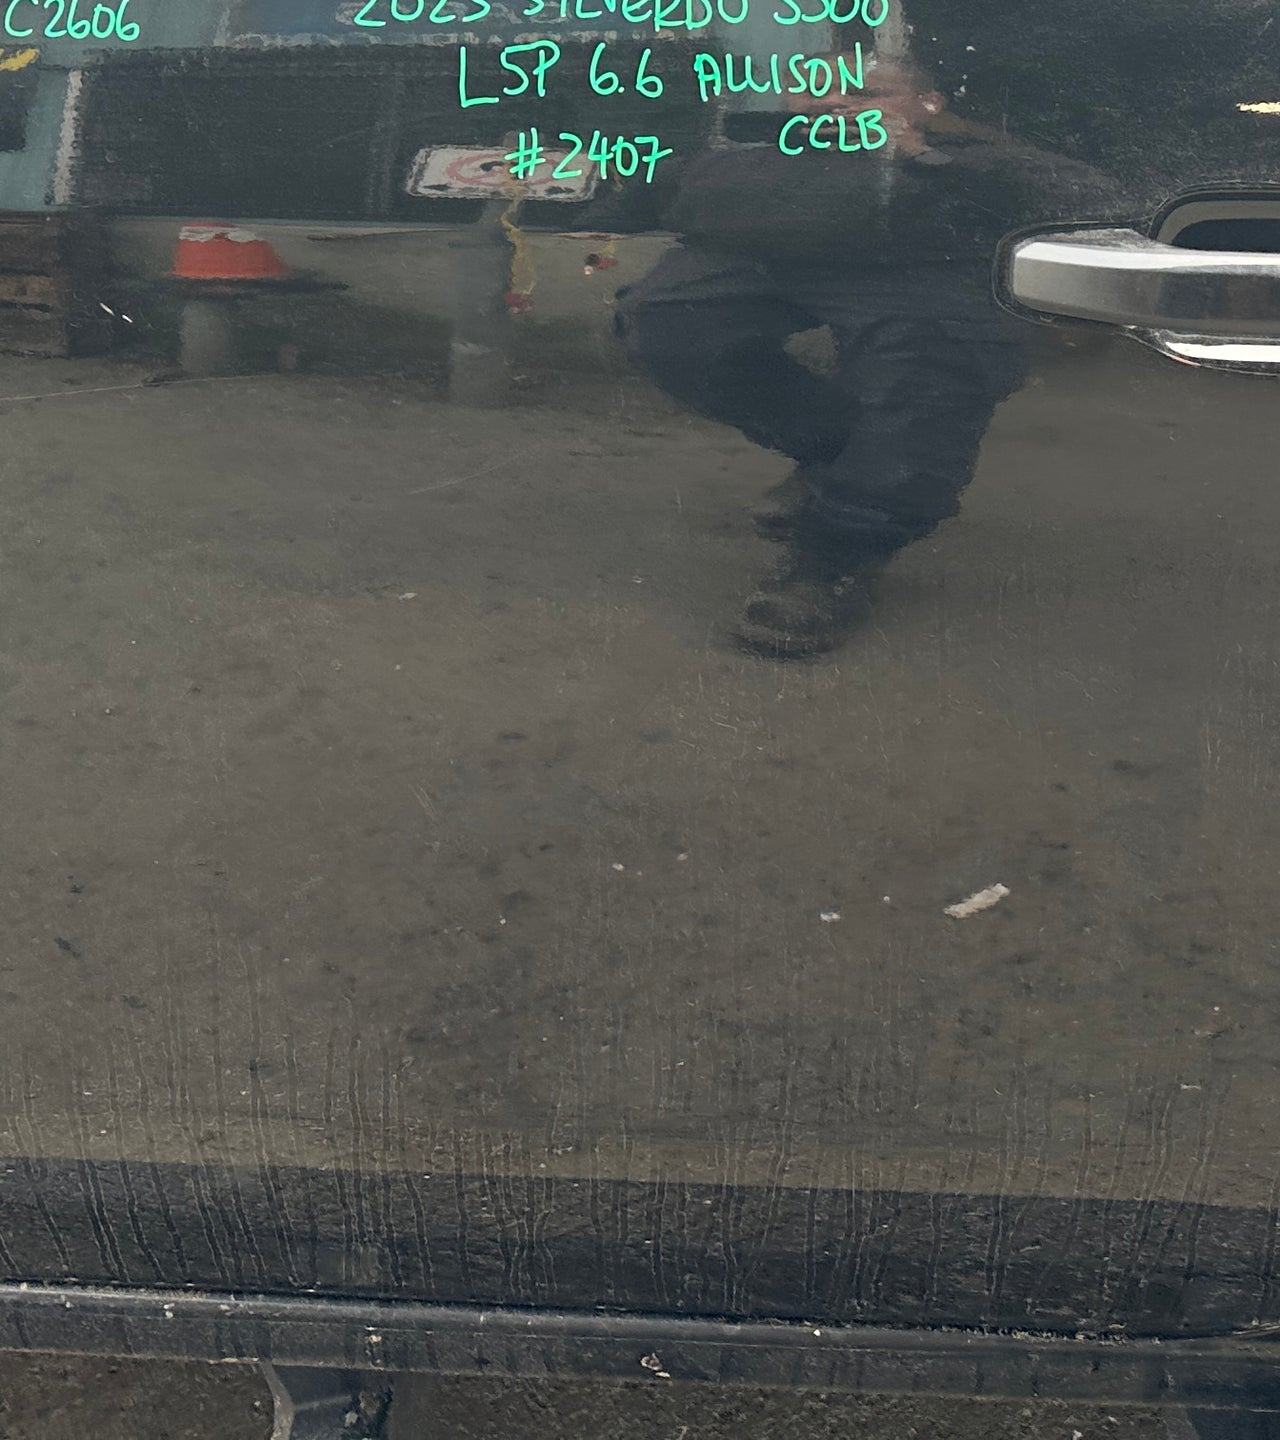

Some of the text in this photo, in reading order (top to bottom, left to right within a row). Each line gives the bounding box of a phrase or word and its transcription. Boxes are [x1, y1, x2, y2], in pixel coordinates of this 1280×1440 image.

[589, 43, 664, 98] 6.6
[694, 41, 866, 102] ALLISON
[505, 128, 673, 183] #2407
[778, 108, 888, 157] CCLB
